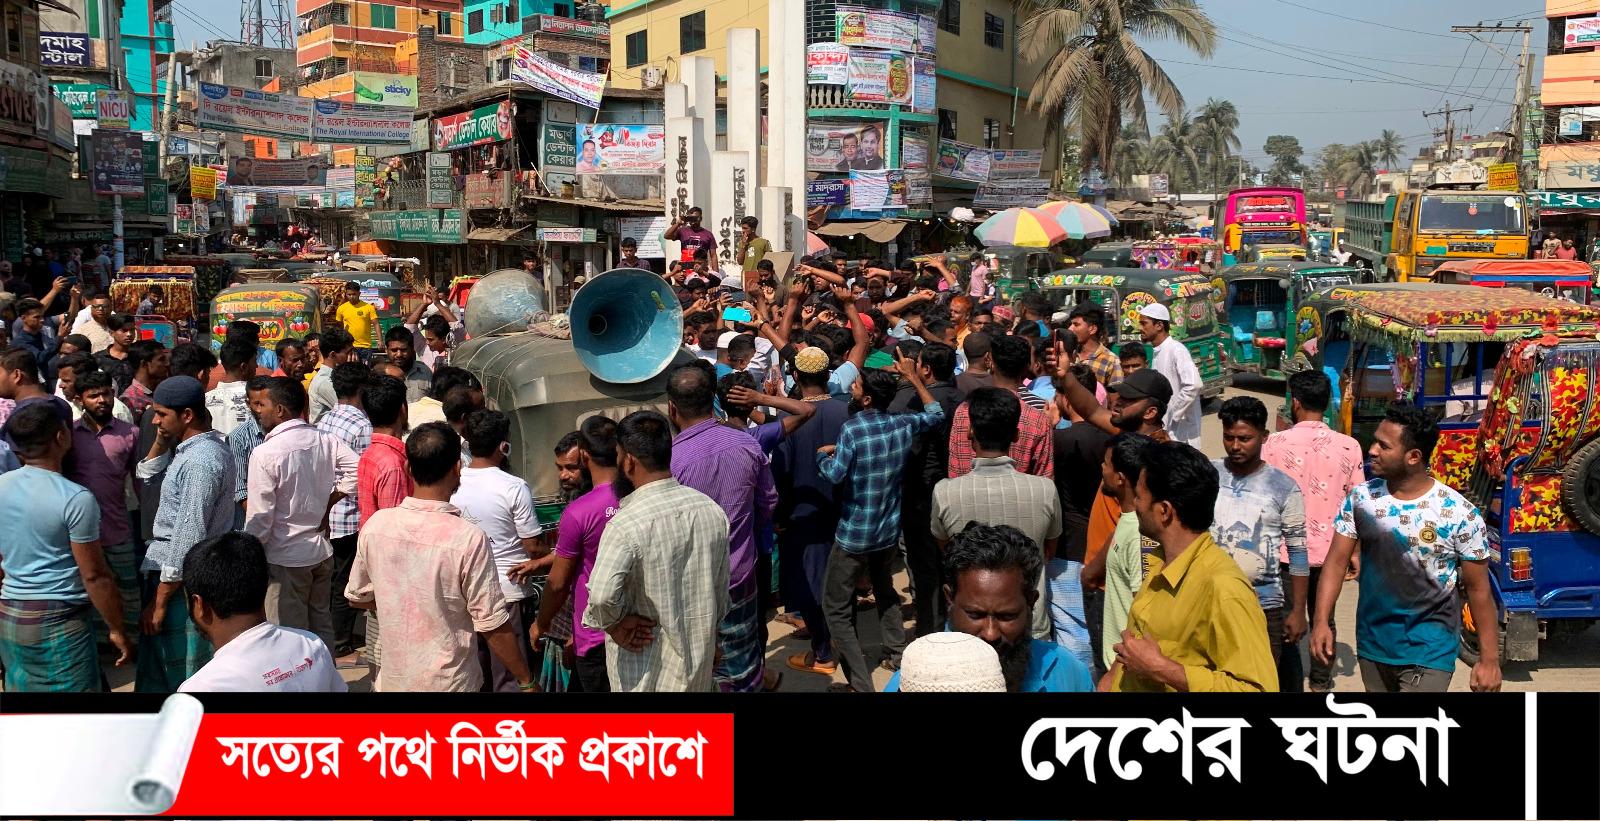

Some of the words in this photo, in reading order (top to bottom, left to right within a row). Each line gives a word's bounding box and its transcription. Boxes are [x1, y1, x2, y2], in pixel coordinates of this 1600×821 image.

[384, 84, 411, 97] sticky
[100, 102, 127, 118] NICU
[316, 127, 328, 135] The
[329, 128, 347, 137] Royal
[348, 129, 387, 138] International
[388, 130, 410, 139] College
